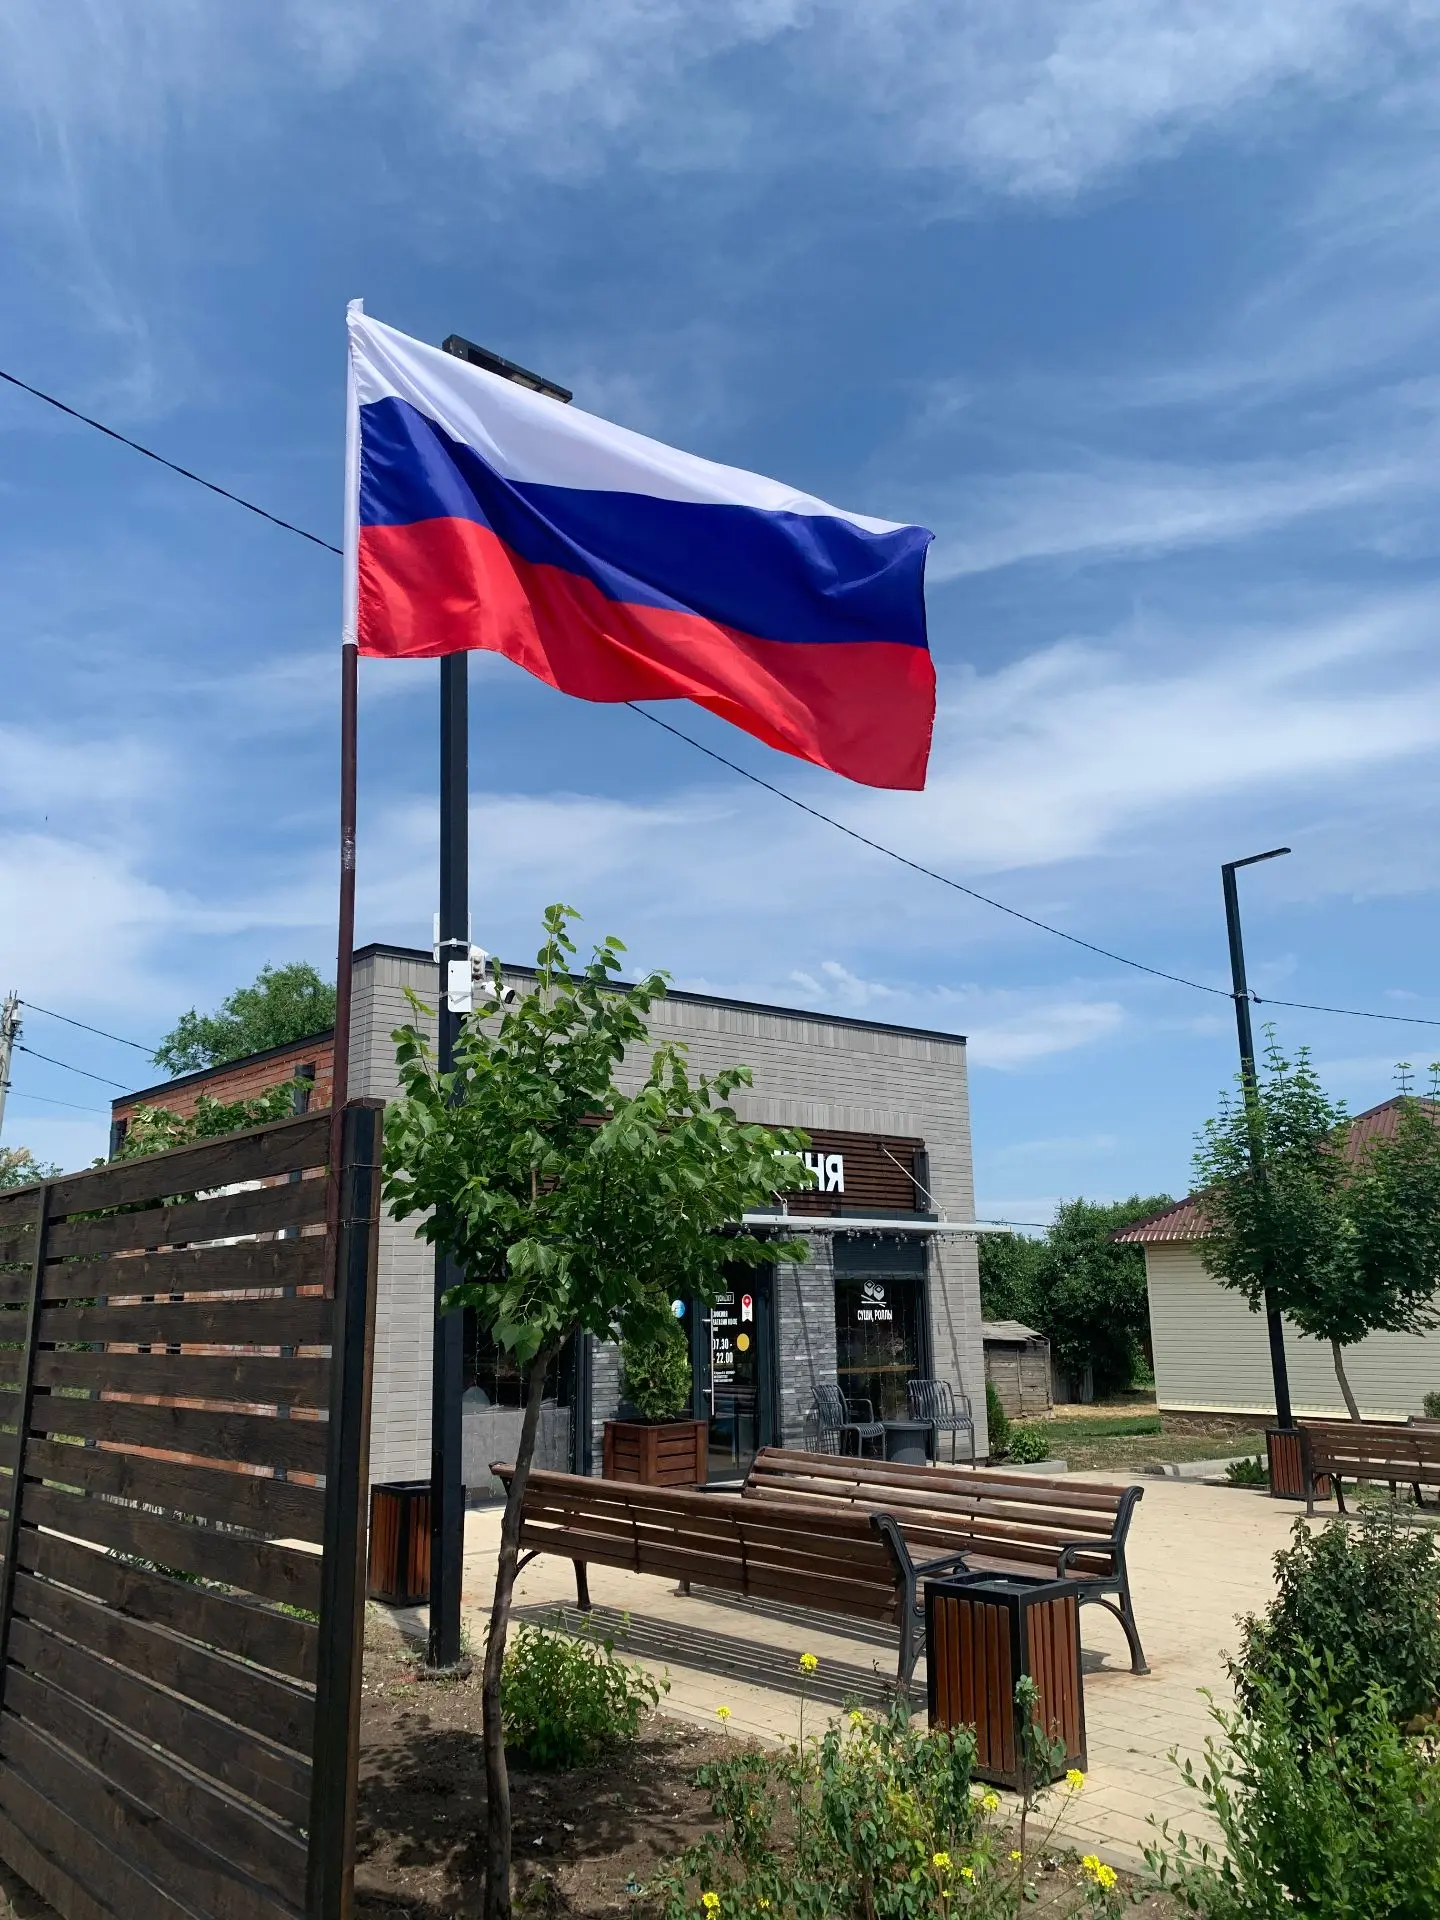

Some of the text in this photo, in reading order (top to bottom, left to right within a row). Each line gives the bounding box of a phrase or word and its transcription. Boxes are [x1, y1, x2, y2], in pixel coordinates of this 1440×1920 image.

[857, 1309, 893, 1323] СУШИ, РОЛЛЫ
[716, 1352, 734, 1364] 22.00
